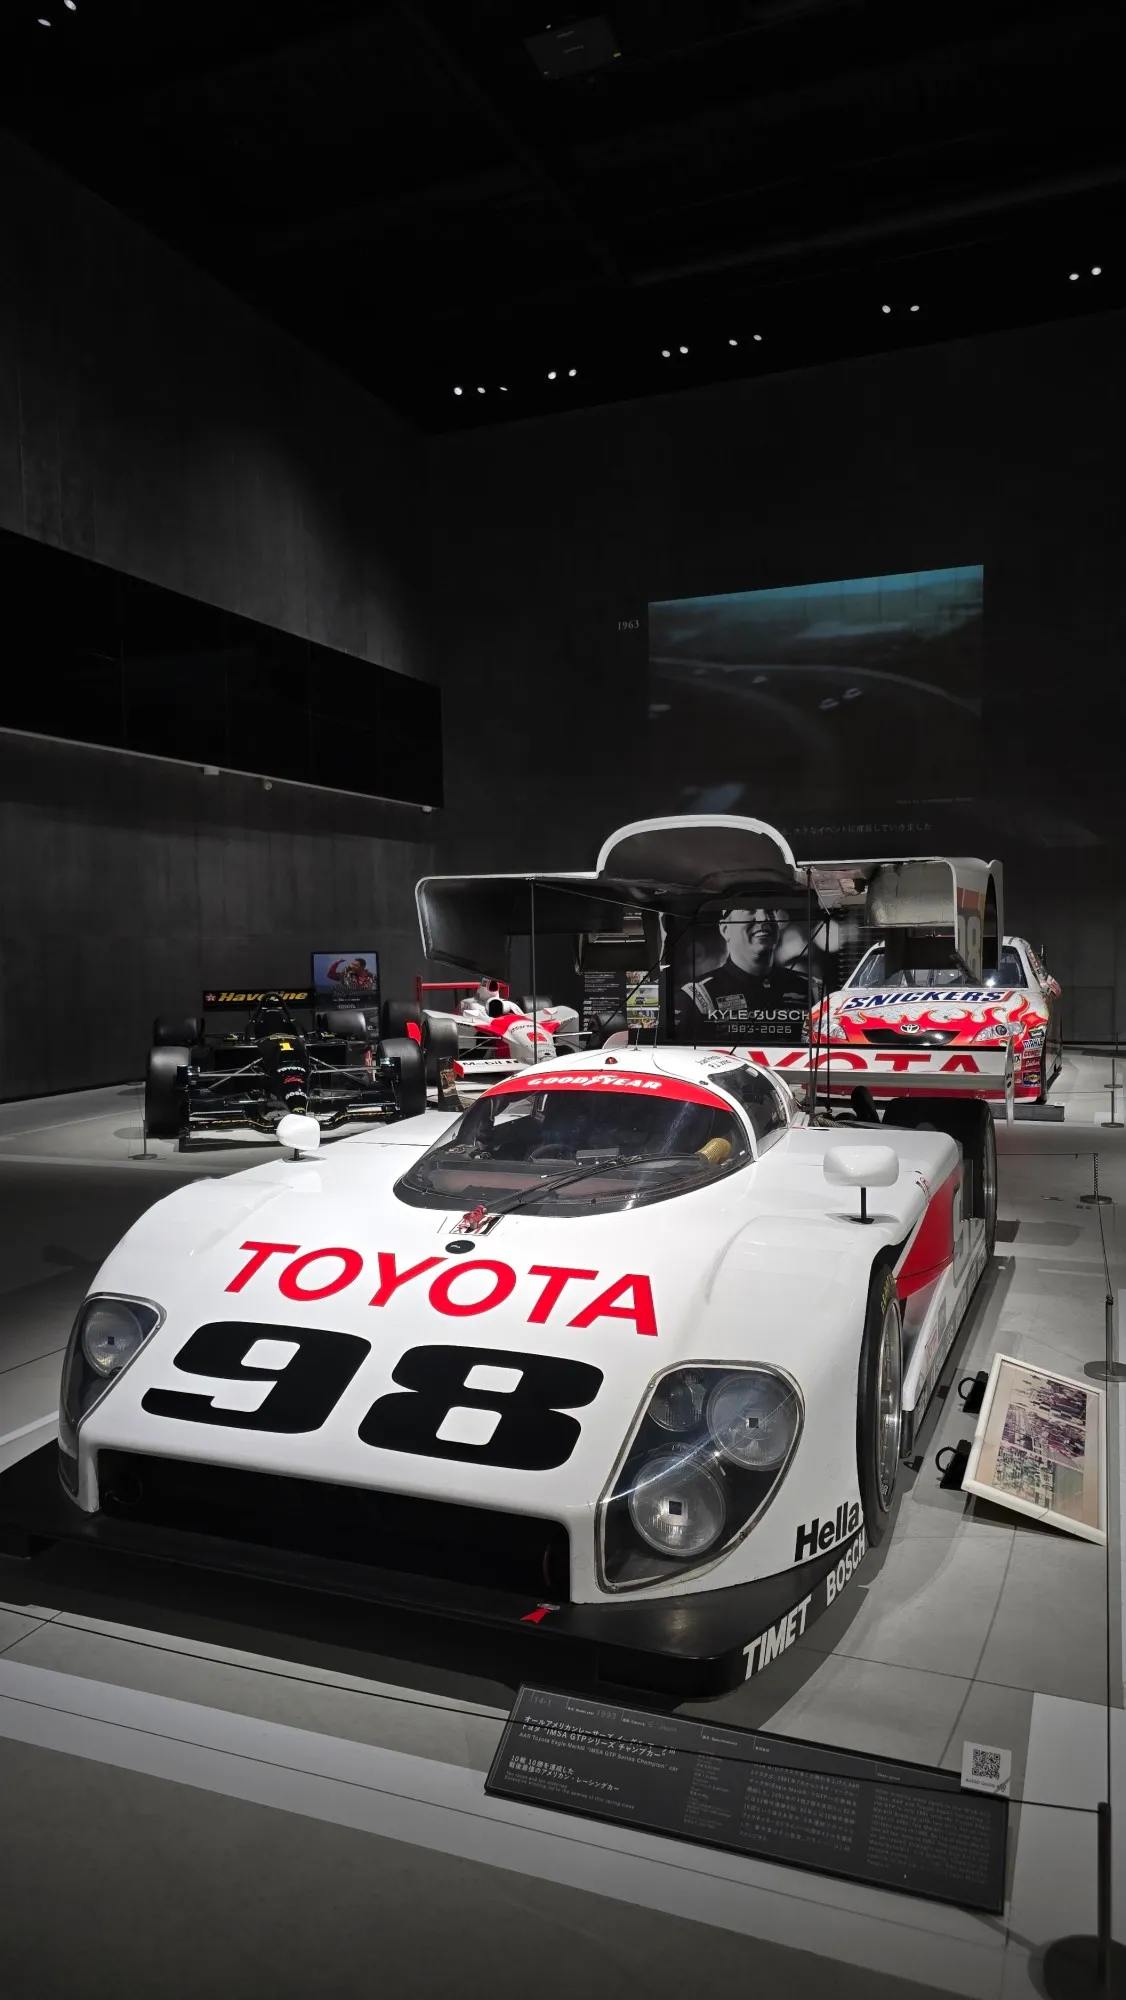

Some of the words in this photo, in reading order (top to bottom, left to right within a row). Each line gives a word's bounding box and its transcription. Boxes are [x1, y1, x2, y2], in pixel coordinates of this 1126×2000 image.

[617, 620, 640, 631] 1963
[708, 1009, 748, 1020] KYLE
[754, 1010, 810, 1021] BUSCH
[844, 991, 1006, 1010] SNICKERS
[279, 1042, 294, 1051] 1
[527, 1074, 662, 1090] GOODYEAR
[224, 1241, 659, 1337] TOYOTA
[141, 1321, 605, 1471] 98
[794, 1501, 859, 1563] Hella
[826, 1527, 866, 1607] BOSCH
[742, 1593, 813, 1681] TIMET
